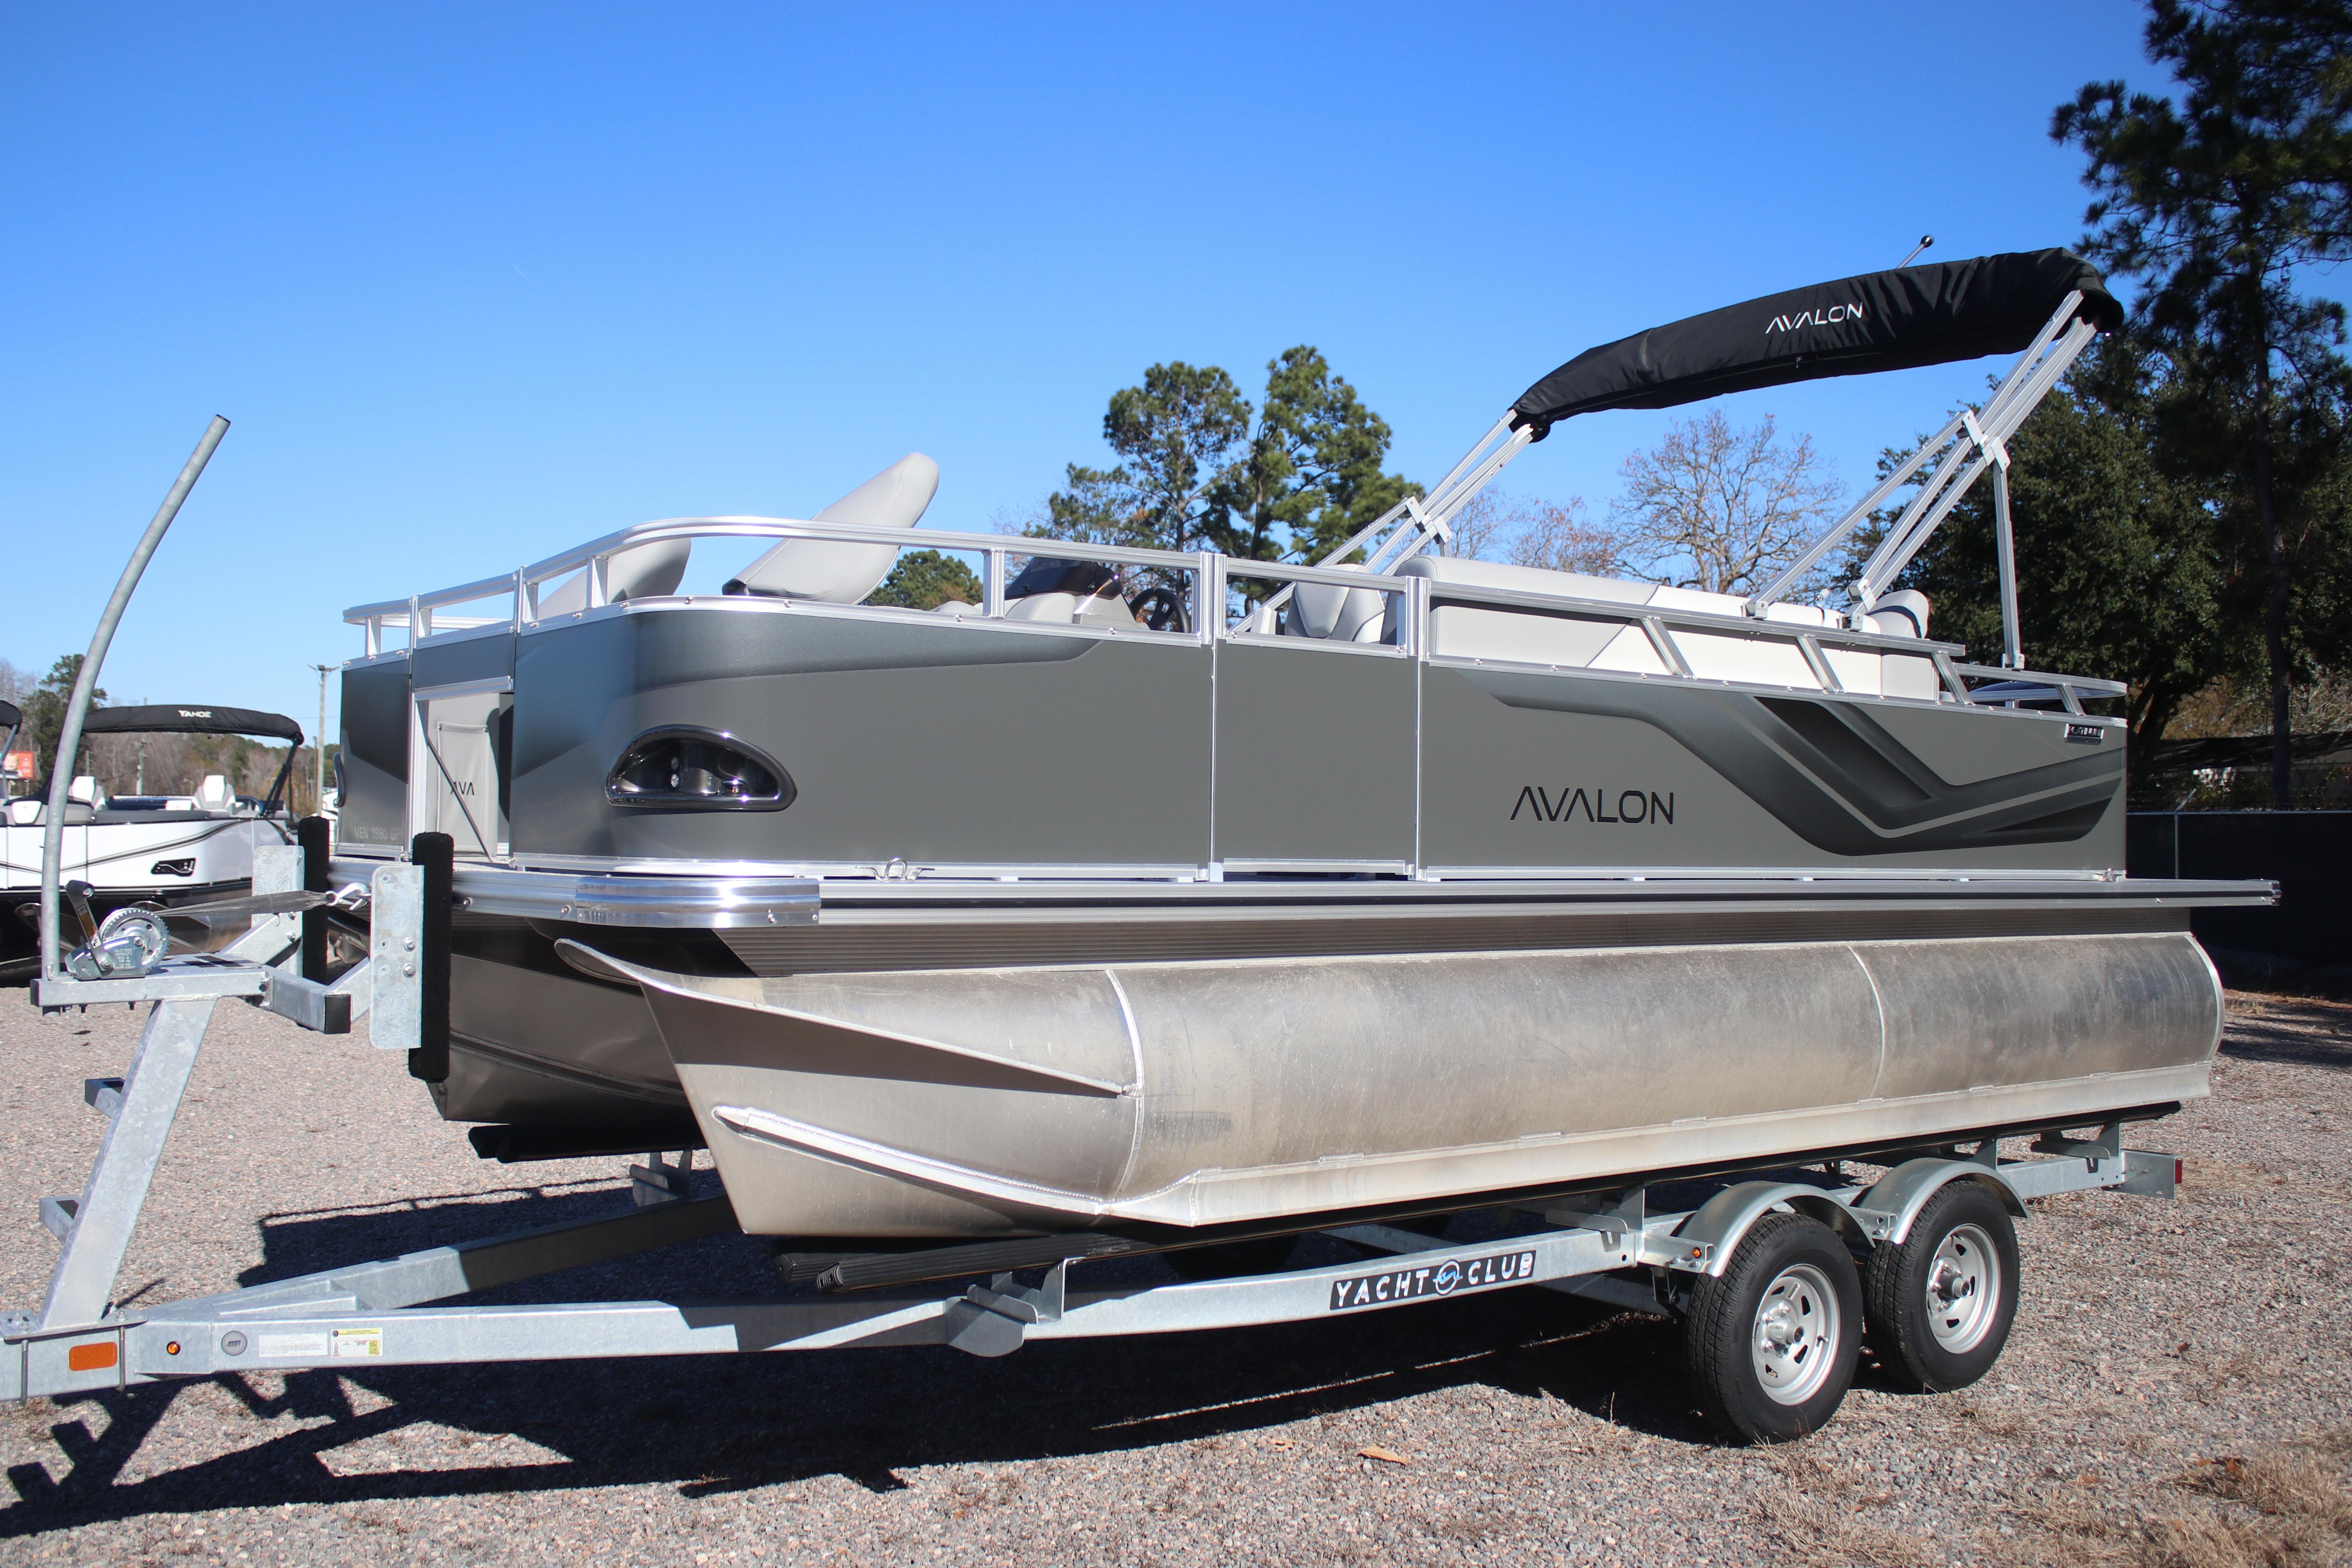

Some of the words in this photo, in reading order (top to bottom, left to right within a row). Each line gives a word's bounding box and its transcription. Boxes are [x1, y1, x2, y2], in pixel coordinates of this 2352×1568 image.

[1765, 301, 1863, 334] AVALON
[1510, 786, 1674, 825] AVALON
[354, 826, 368, 839] VEN
[1336, 1269, 1430, 1308] YACHT
[1468, 1252, 1534, 1285] CLUB
